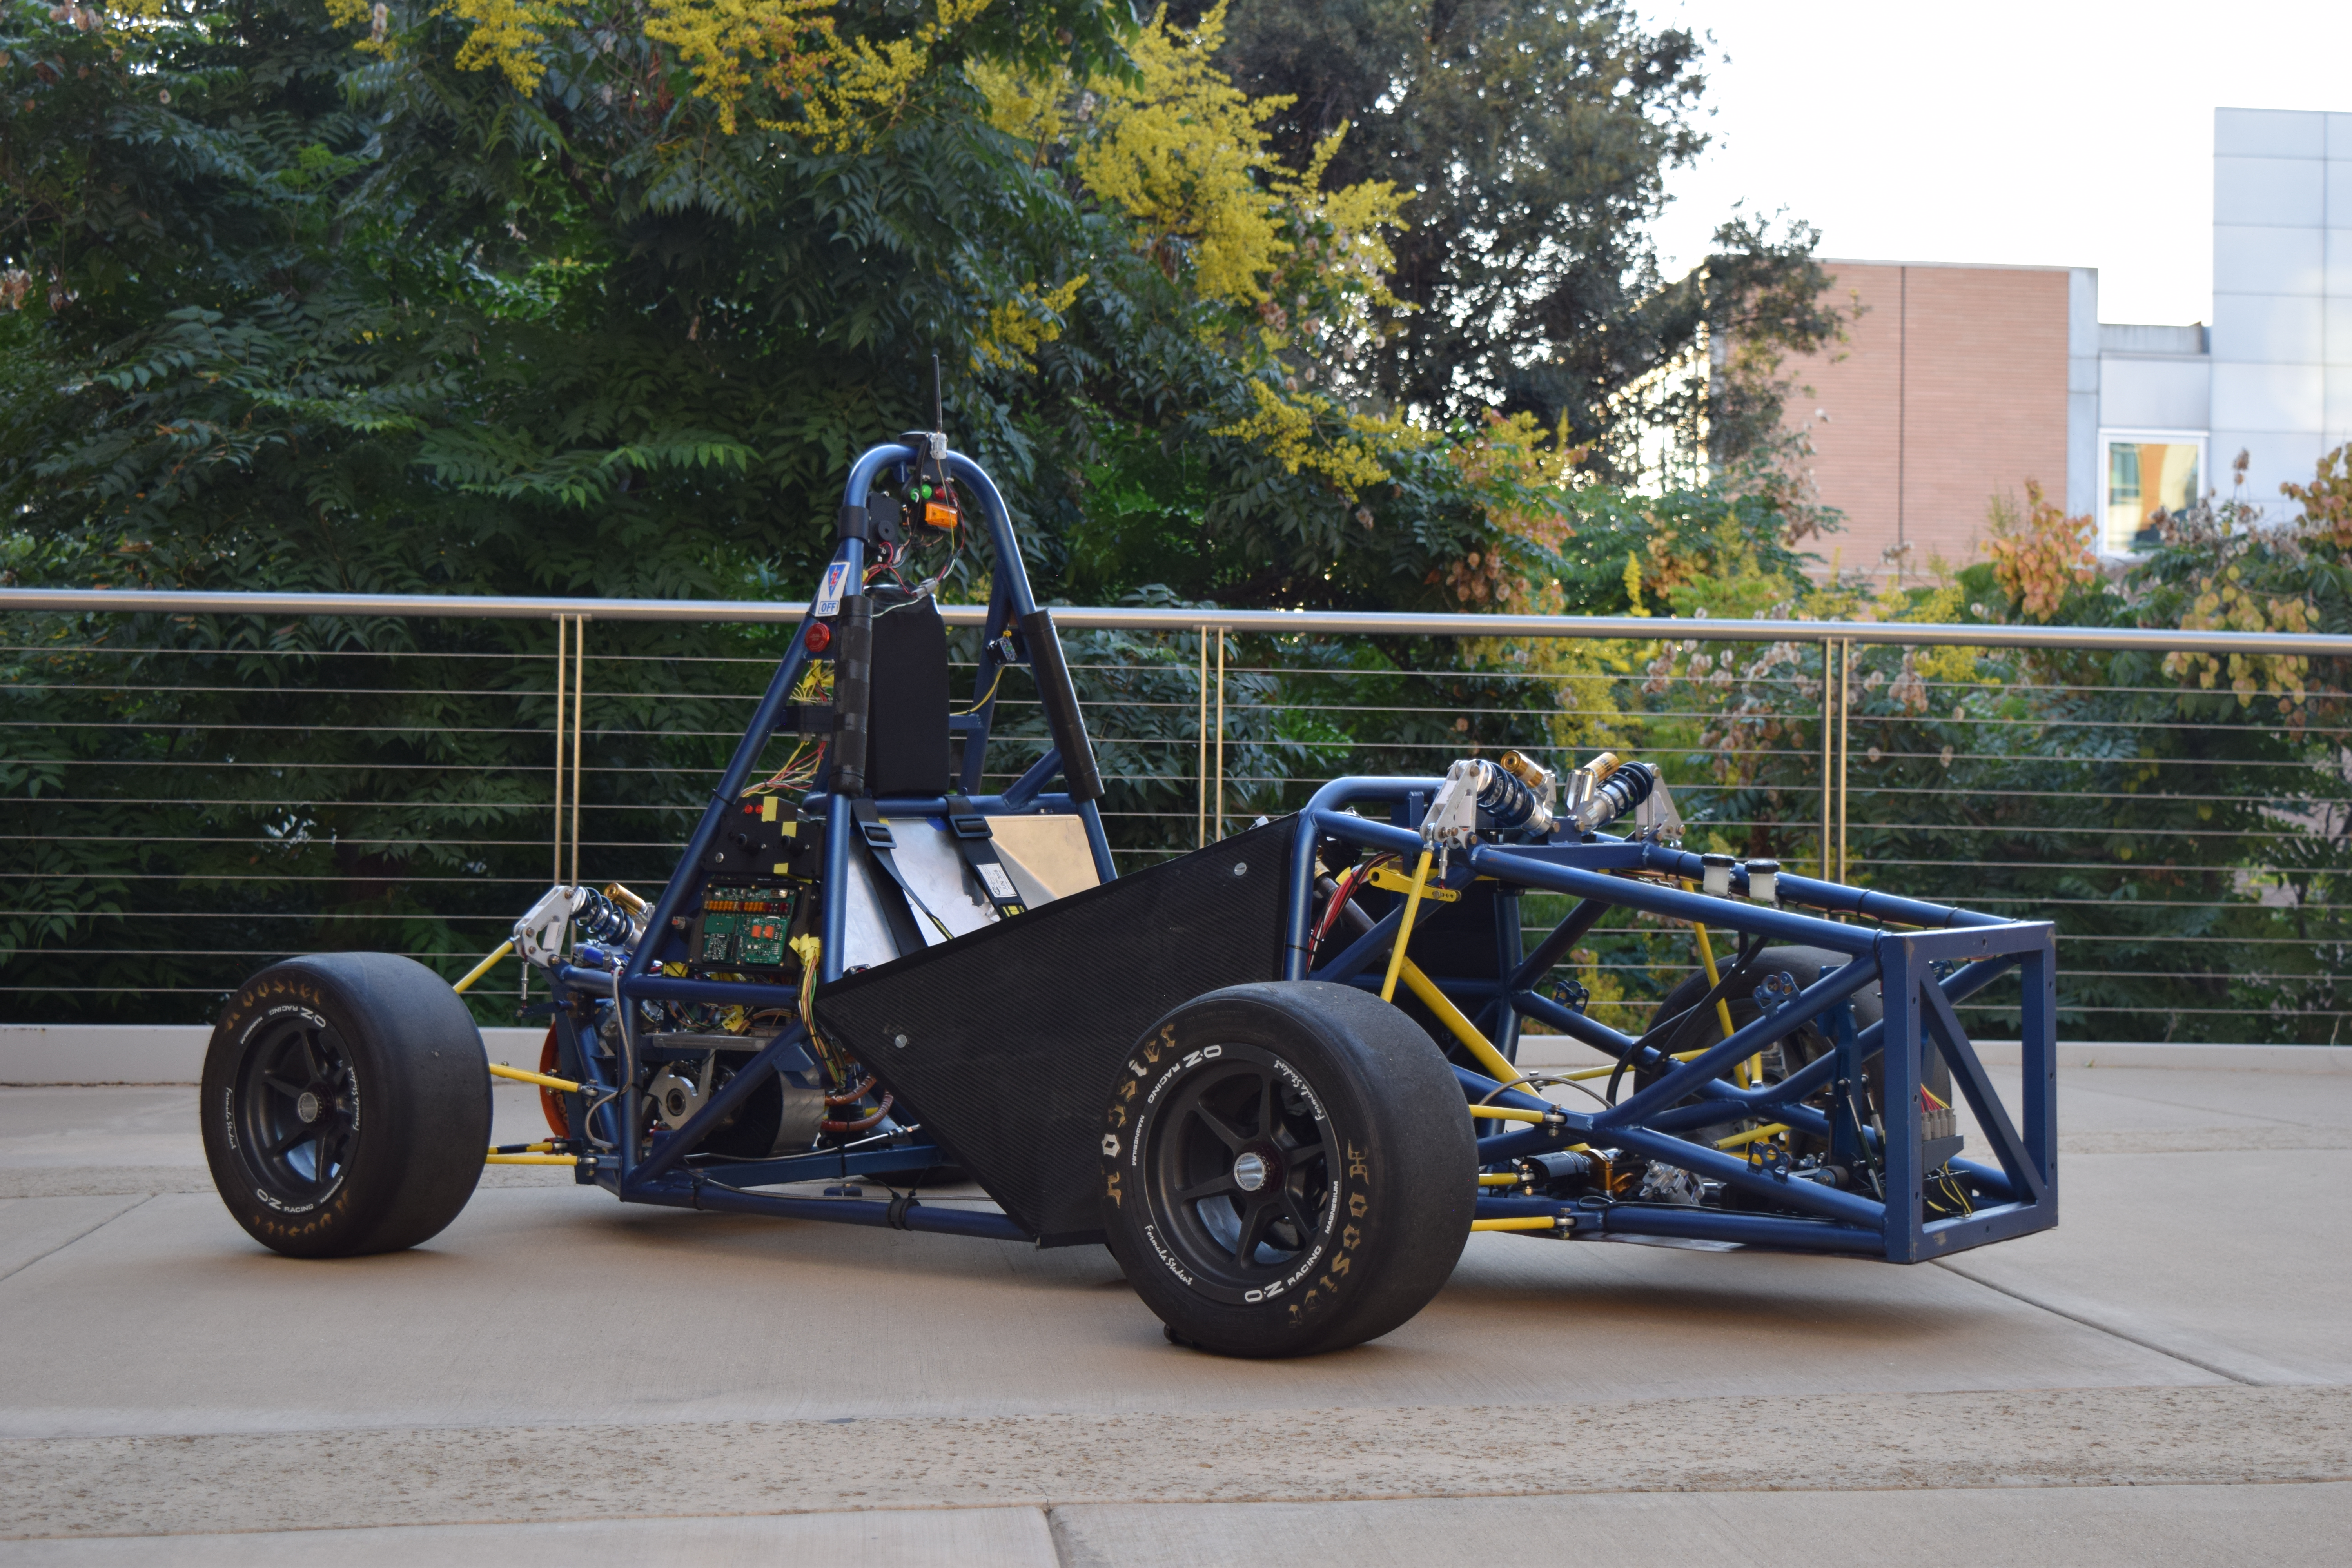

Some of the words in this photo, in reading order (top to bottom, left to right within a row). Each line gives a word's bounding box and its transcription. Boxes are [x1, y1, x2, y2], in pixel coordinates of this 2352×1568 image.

[821, 603, 836, 612] OFF
[269, 1005, 298, 1015] RACING
[240, 1016, 263, 1044] MAGNESIUM
[348, 1066, 358, 1095] Student
[1147, 1063, 1180, 1103] RACING
[1274, 1060, 1302, 1087] Student
[1301, 1084, 1325, 1120] Formula
[227, 1121, 236, 1149] Student
[1132, 1115, 1145, 1166] MAGNESIUM
[284, 1204, 314, 1212] RACING
[320, 1176, 344, 1203] MAGNESIUM
[1287, 1245, 1322, 1286] RACING
[1325, 1181, 1338, 1234] MAGNESIUM
[1145, 1225, 1167, 1261] Formula
[1165, 1258, 1192, 1285] Student
